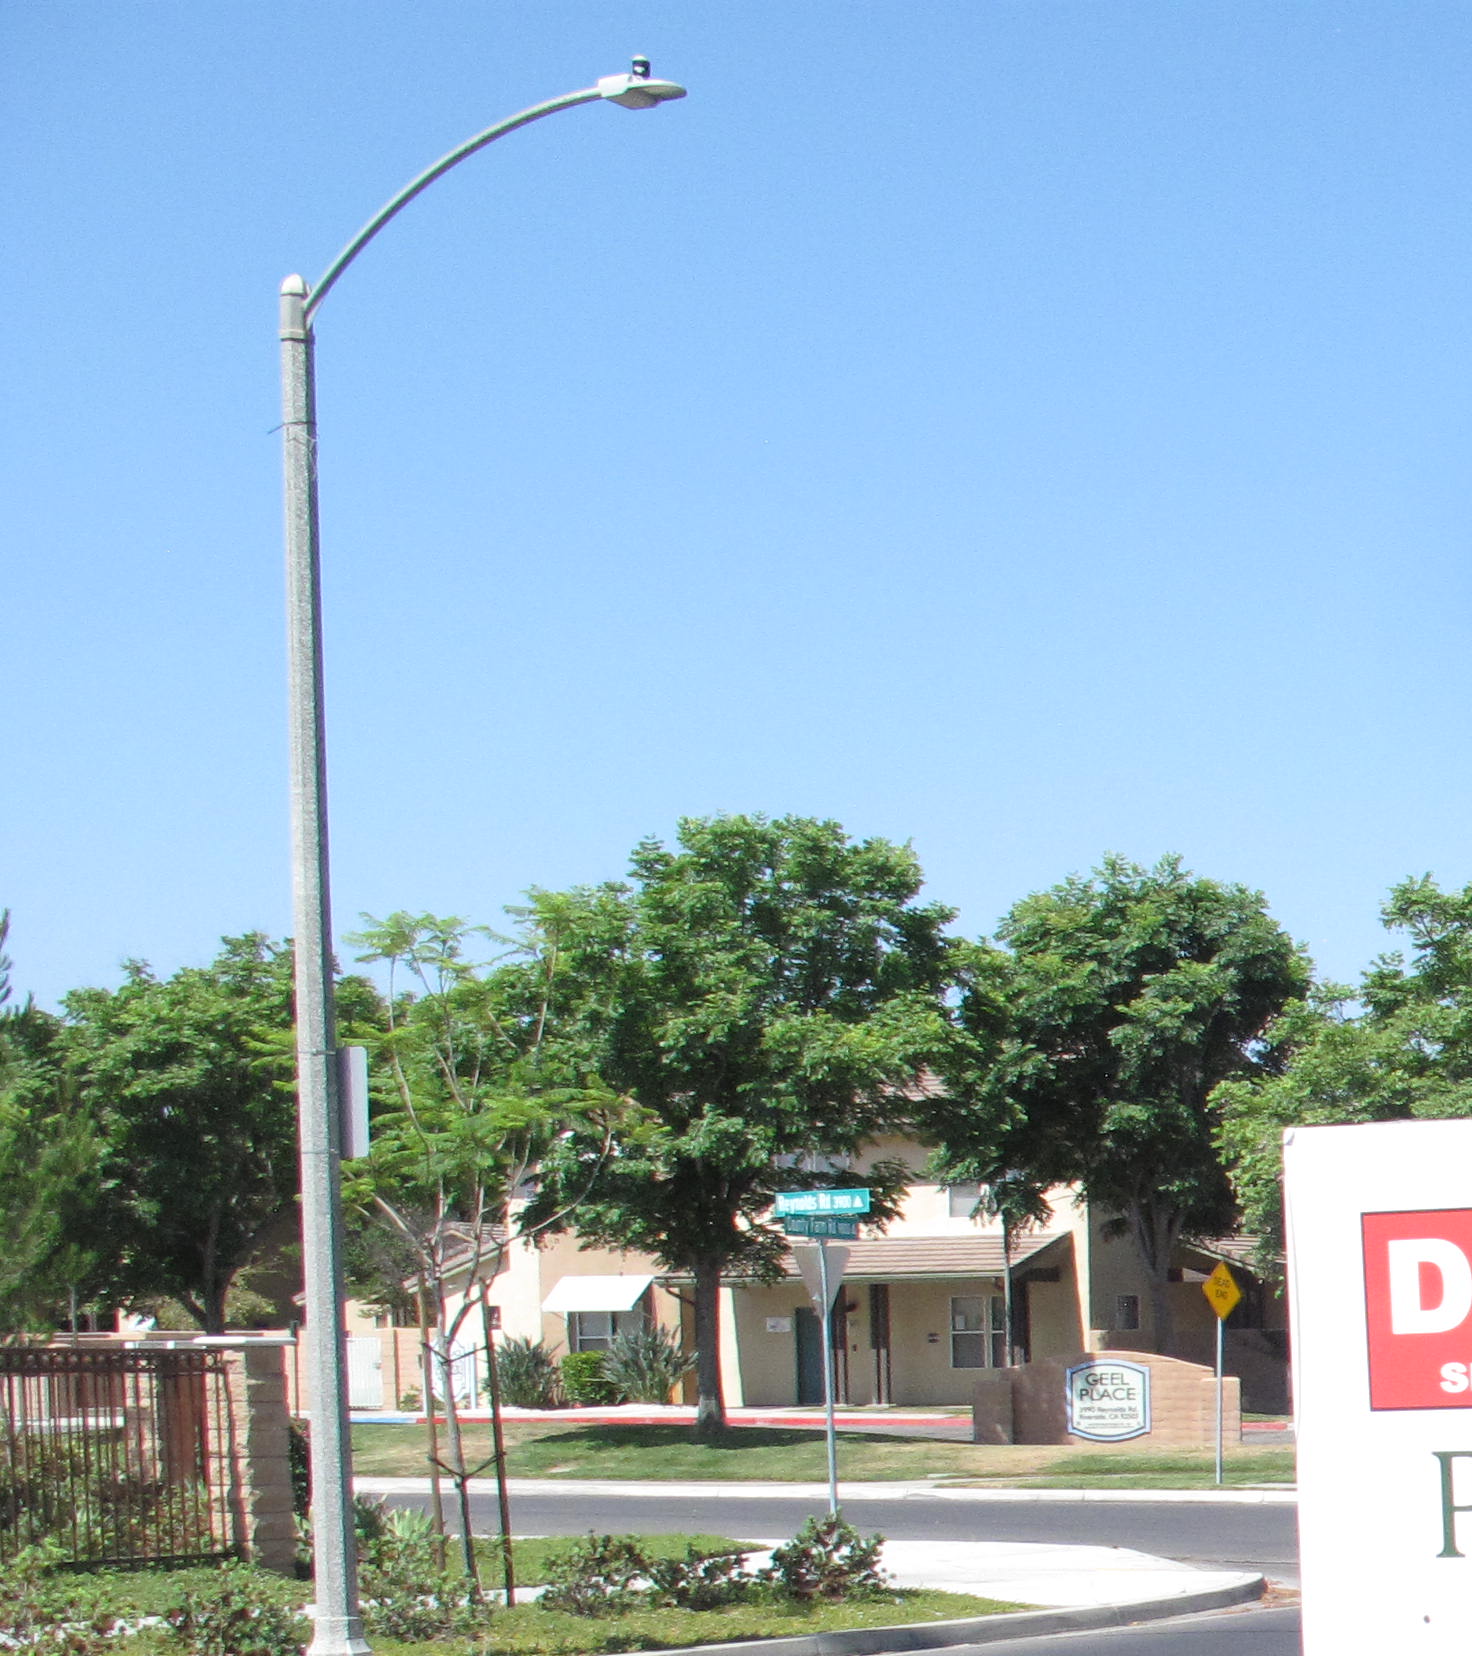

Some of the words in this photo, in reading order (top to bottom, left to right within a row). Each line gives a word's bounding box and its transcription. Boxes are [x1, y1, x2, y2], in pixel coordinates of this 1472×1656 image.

[778, 1195, 817, 1214] Reynolds
[818, 1193, 831, 1209] Rd
[1085, 1373, 1130, 1386] GEEL
[1079, 1387, 1137, 1401] PLACE
